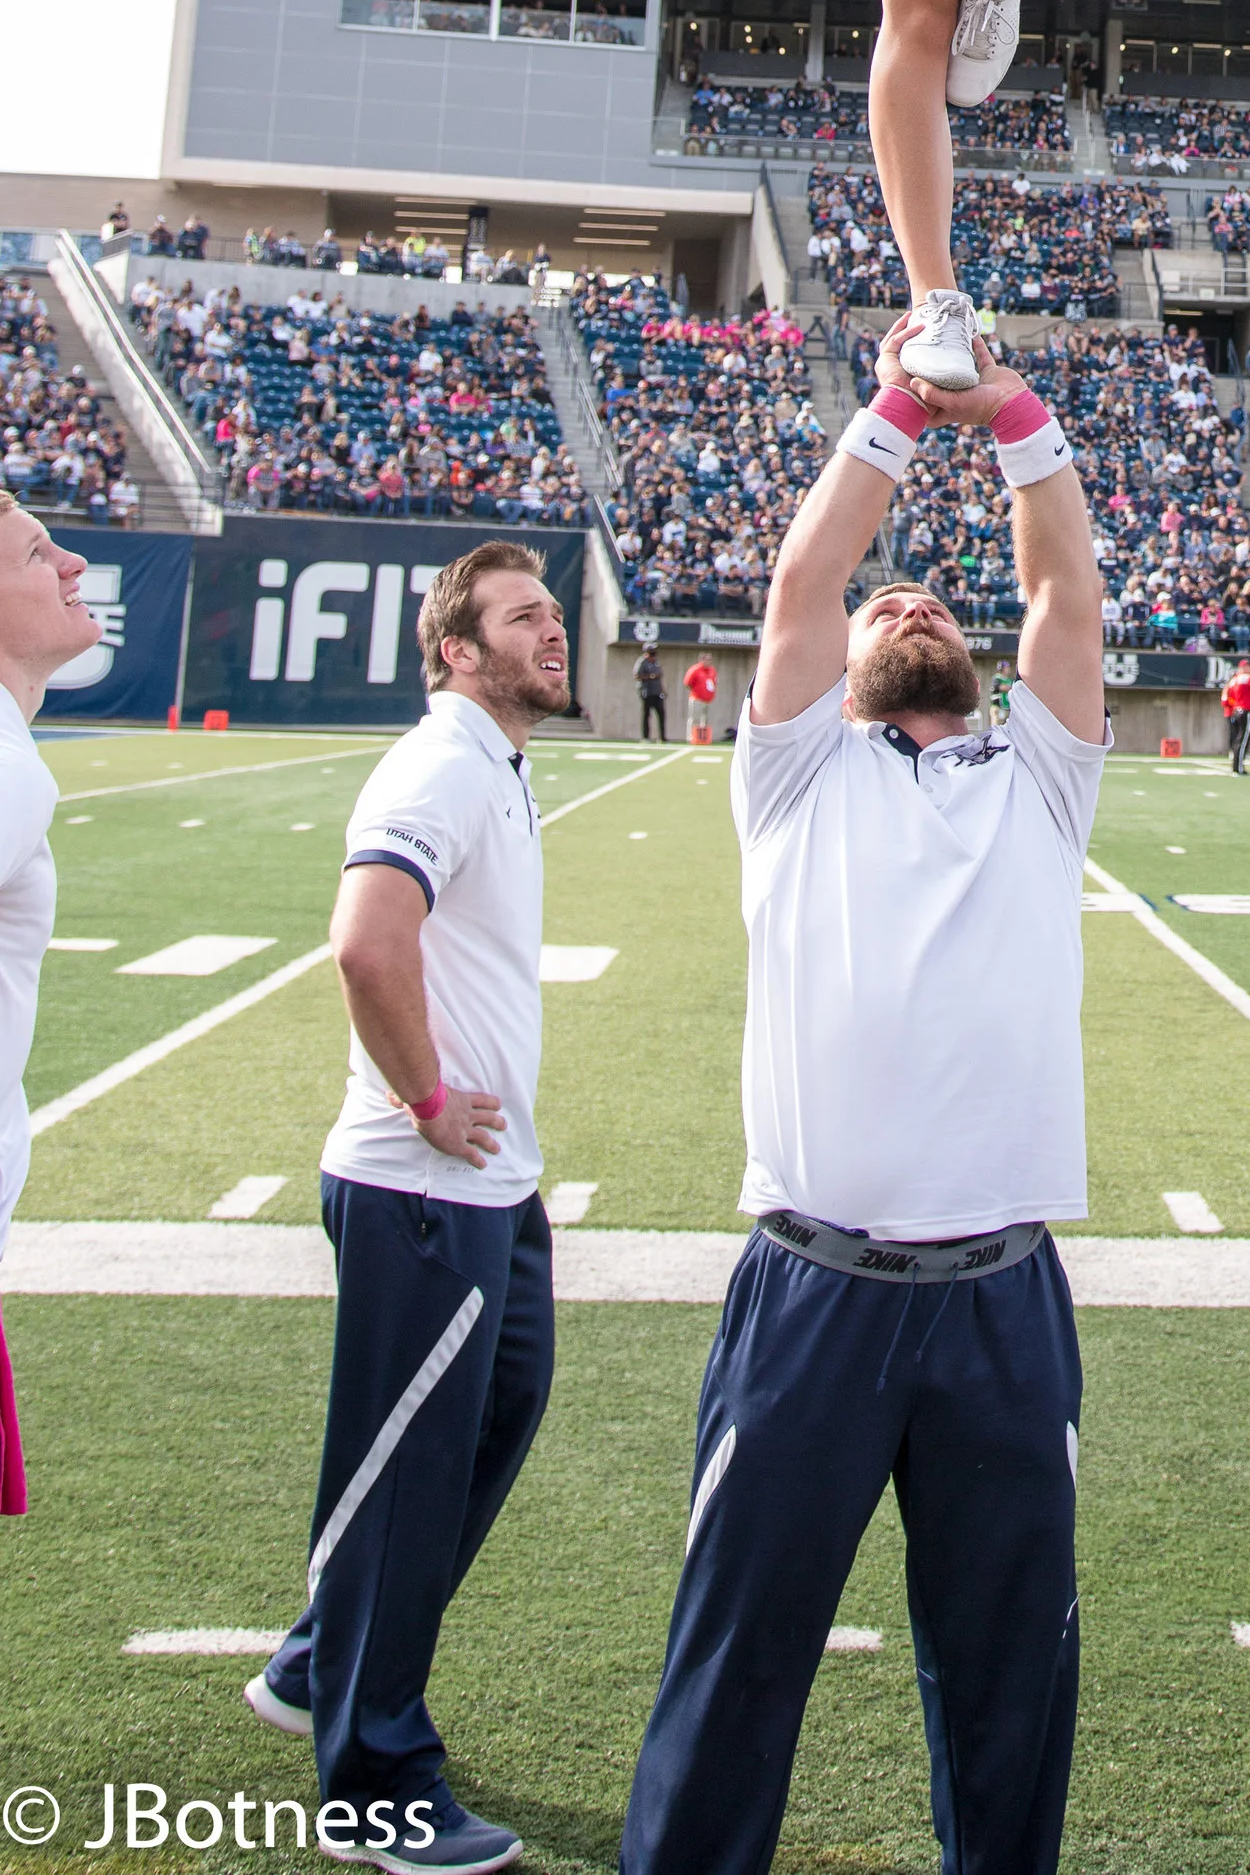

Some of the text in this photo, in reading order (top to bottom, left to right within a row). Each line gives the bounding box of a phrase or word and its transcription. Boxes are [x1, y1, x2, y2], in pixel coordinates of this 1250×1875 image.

[249, 558, 444, 683] iFI
[386, 828, 439, 866] UTAH STATE
[775, 1213, 1006, 1273] NIKE NIKE NIKE
